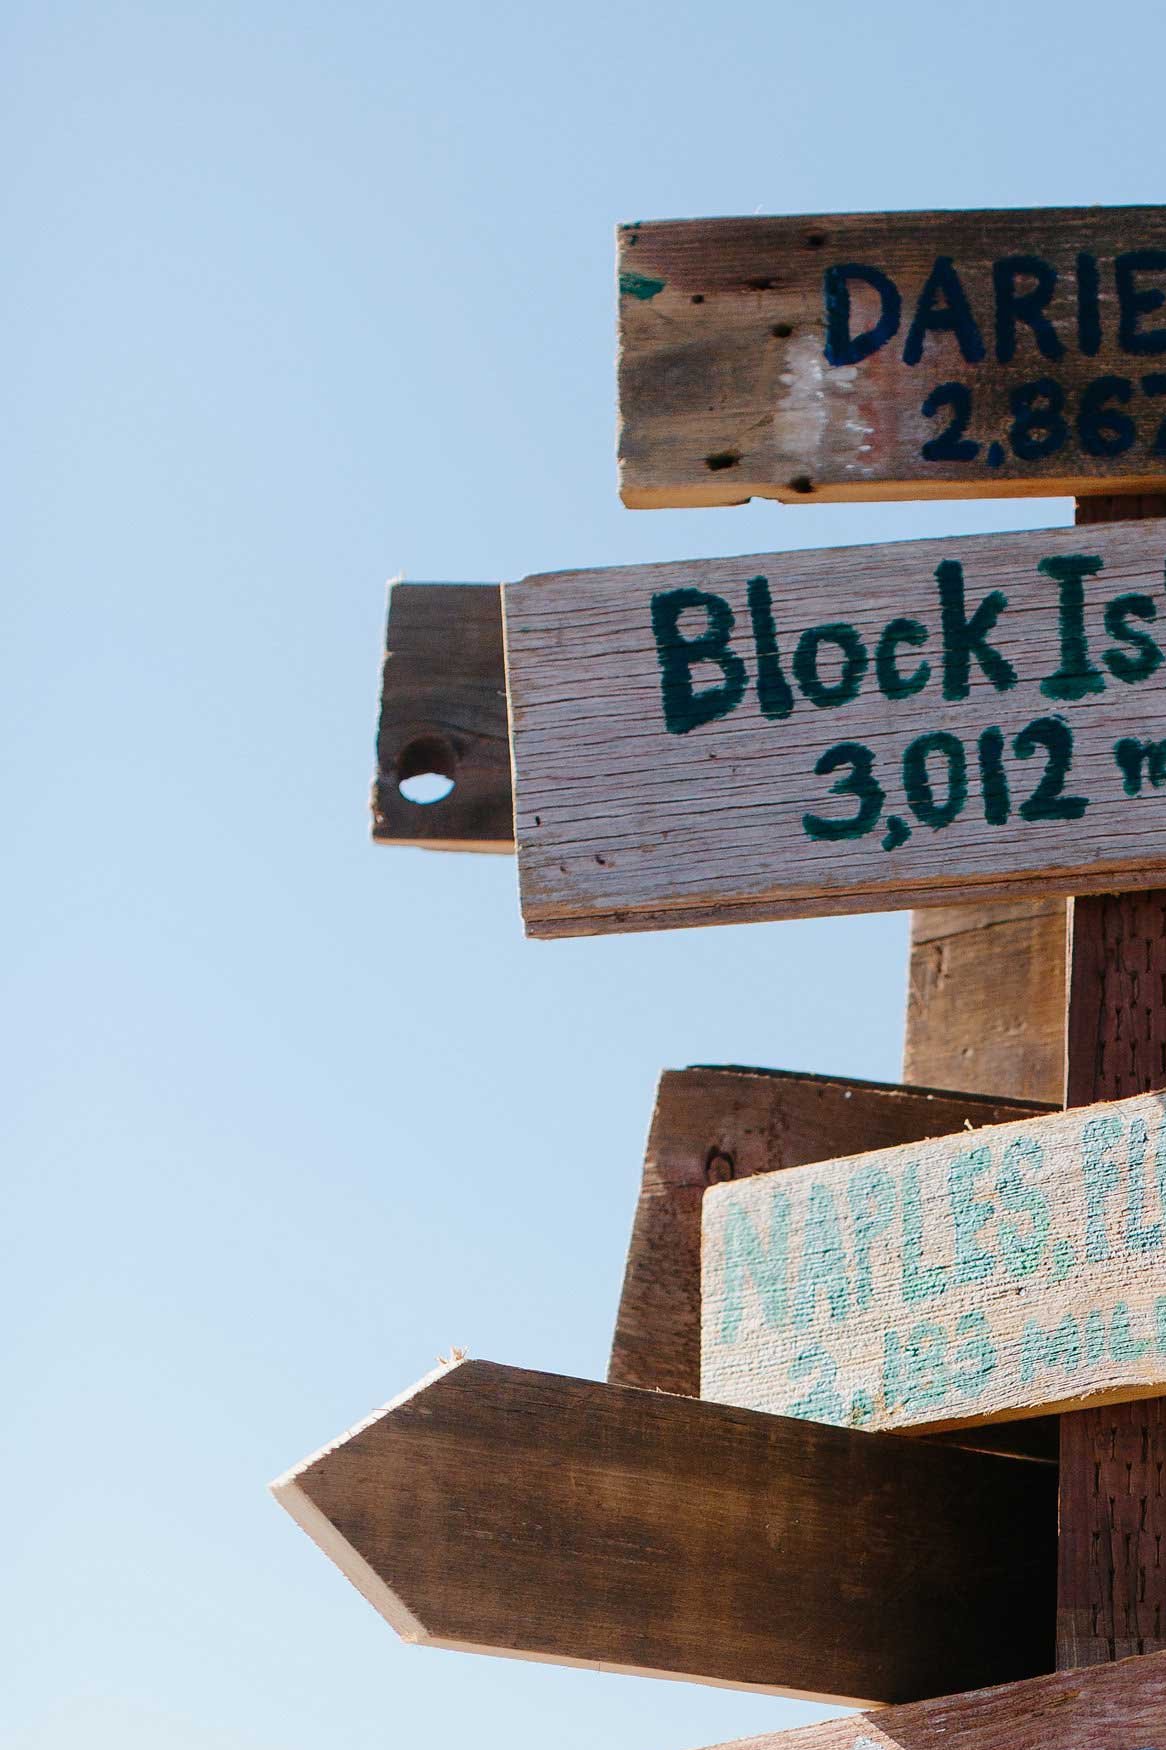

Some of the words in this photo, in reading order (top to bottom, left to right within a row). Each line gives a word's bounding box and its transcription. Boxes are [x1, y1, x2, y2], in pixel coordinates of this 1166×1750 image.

[650, 559, 1017, 734] Block
[802, 715, 1089, 851] 3,012
[719, 1136, 1075, 1345] NAPLES,
